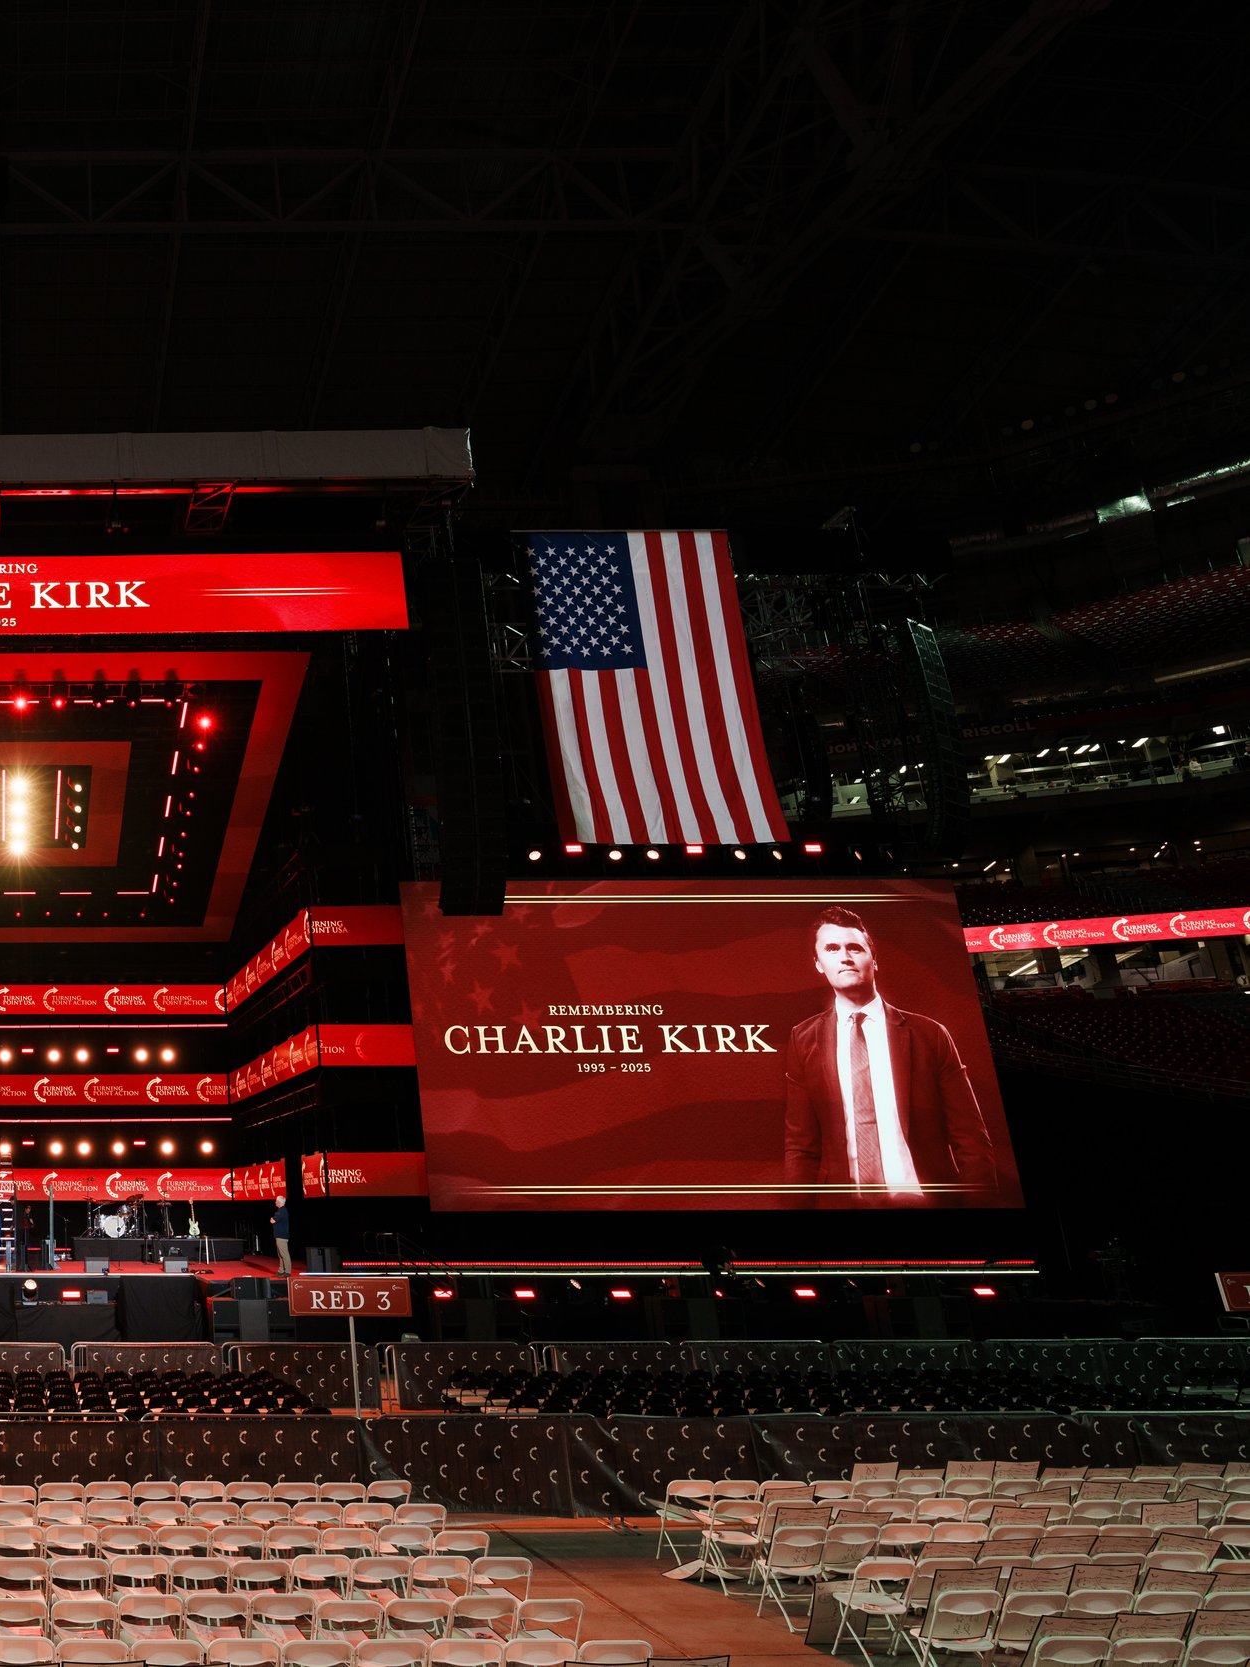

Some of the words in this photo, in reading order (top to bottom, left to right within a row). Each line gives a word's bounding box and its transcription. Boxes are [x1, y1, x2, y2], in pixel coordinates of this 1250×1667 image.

[30, 581, 150, 608] KIRK
[962, 720, 1038, 738] RISCOLL
[1179, 919, 1215, 927] TURNING
[998, 932, 1031, 940] TURNING
[548, 1005, 664, 1016] REMEMBERING
[444, 1025, 644, 1054] CHARLIE
[658, 1024, 777, 1053] KIRK
[577, 1063, 605, 1072] 1993
[621, 1063, 651, 1073] 2025
[350, 1176, 367, 1184] USA
[310, 1290, 365, 1310] RED
[376, 1291, 391, 1311] 3
